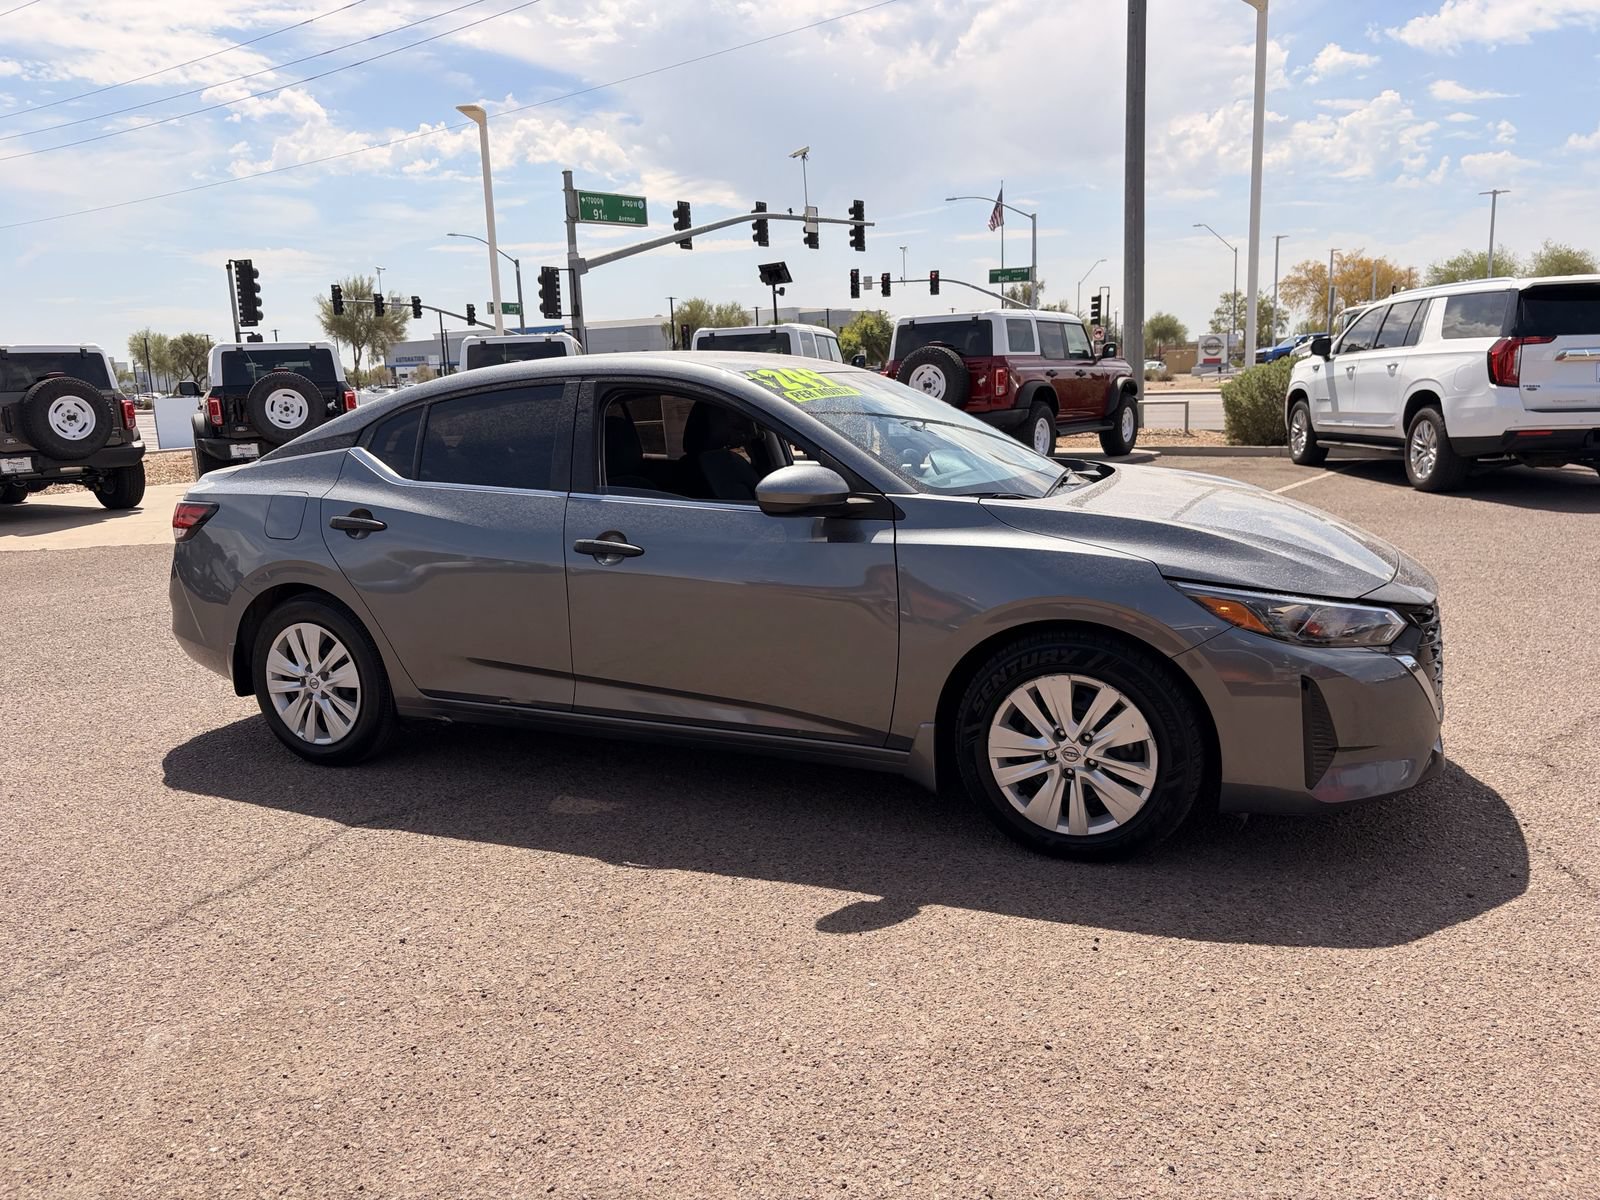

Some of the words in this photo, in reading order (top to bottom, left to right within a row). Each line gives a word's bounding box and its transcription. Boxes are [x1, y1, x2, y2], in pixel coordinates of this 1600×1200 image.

[790, 389, 815, 400] PER
[815, 386, 856, 398] MONTH
[972, 648, 1082, 713] SENTURY
